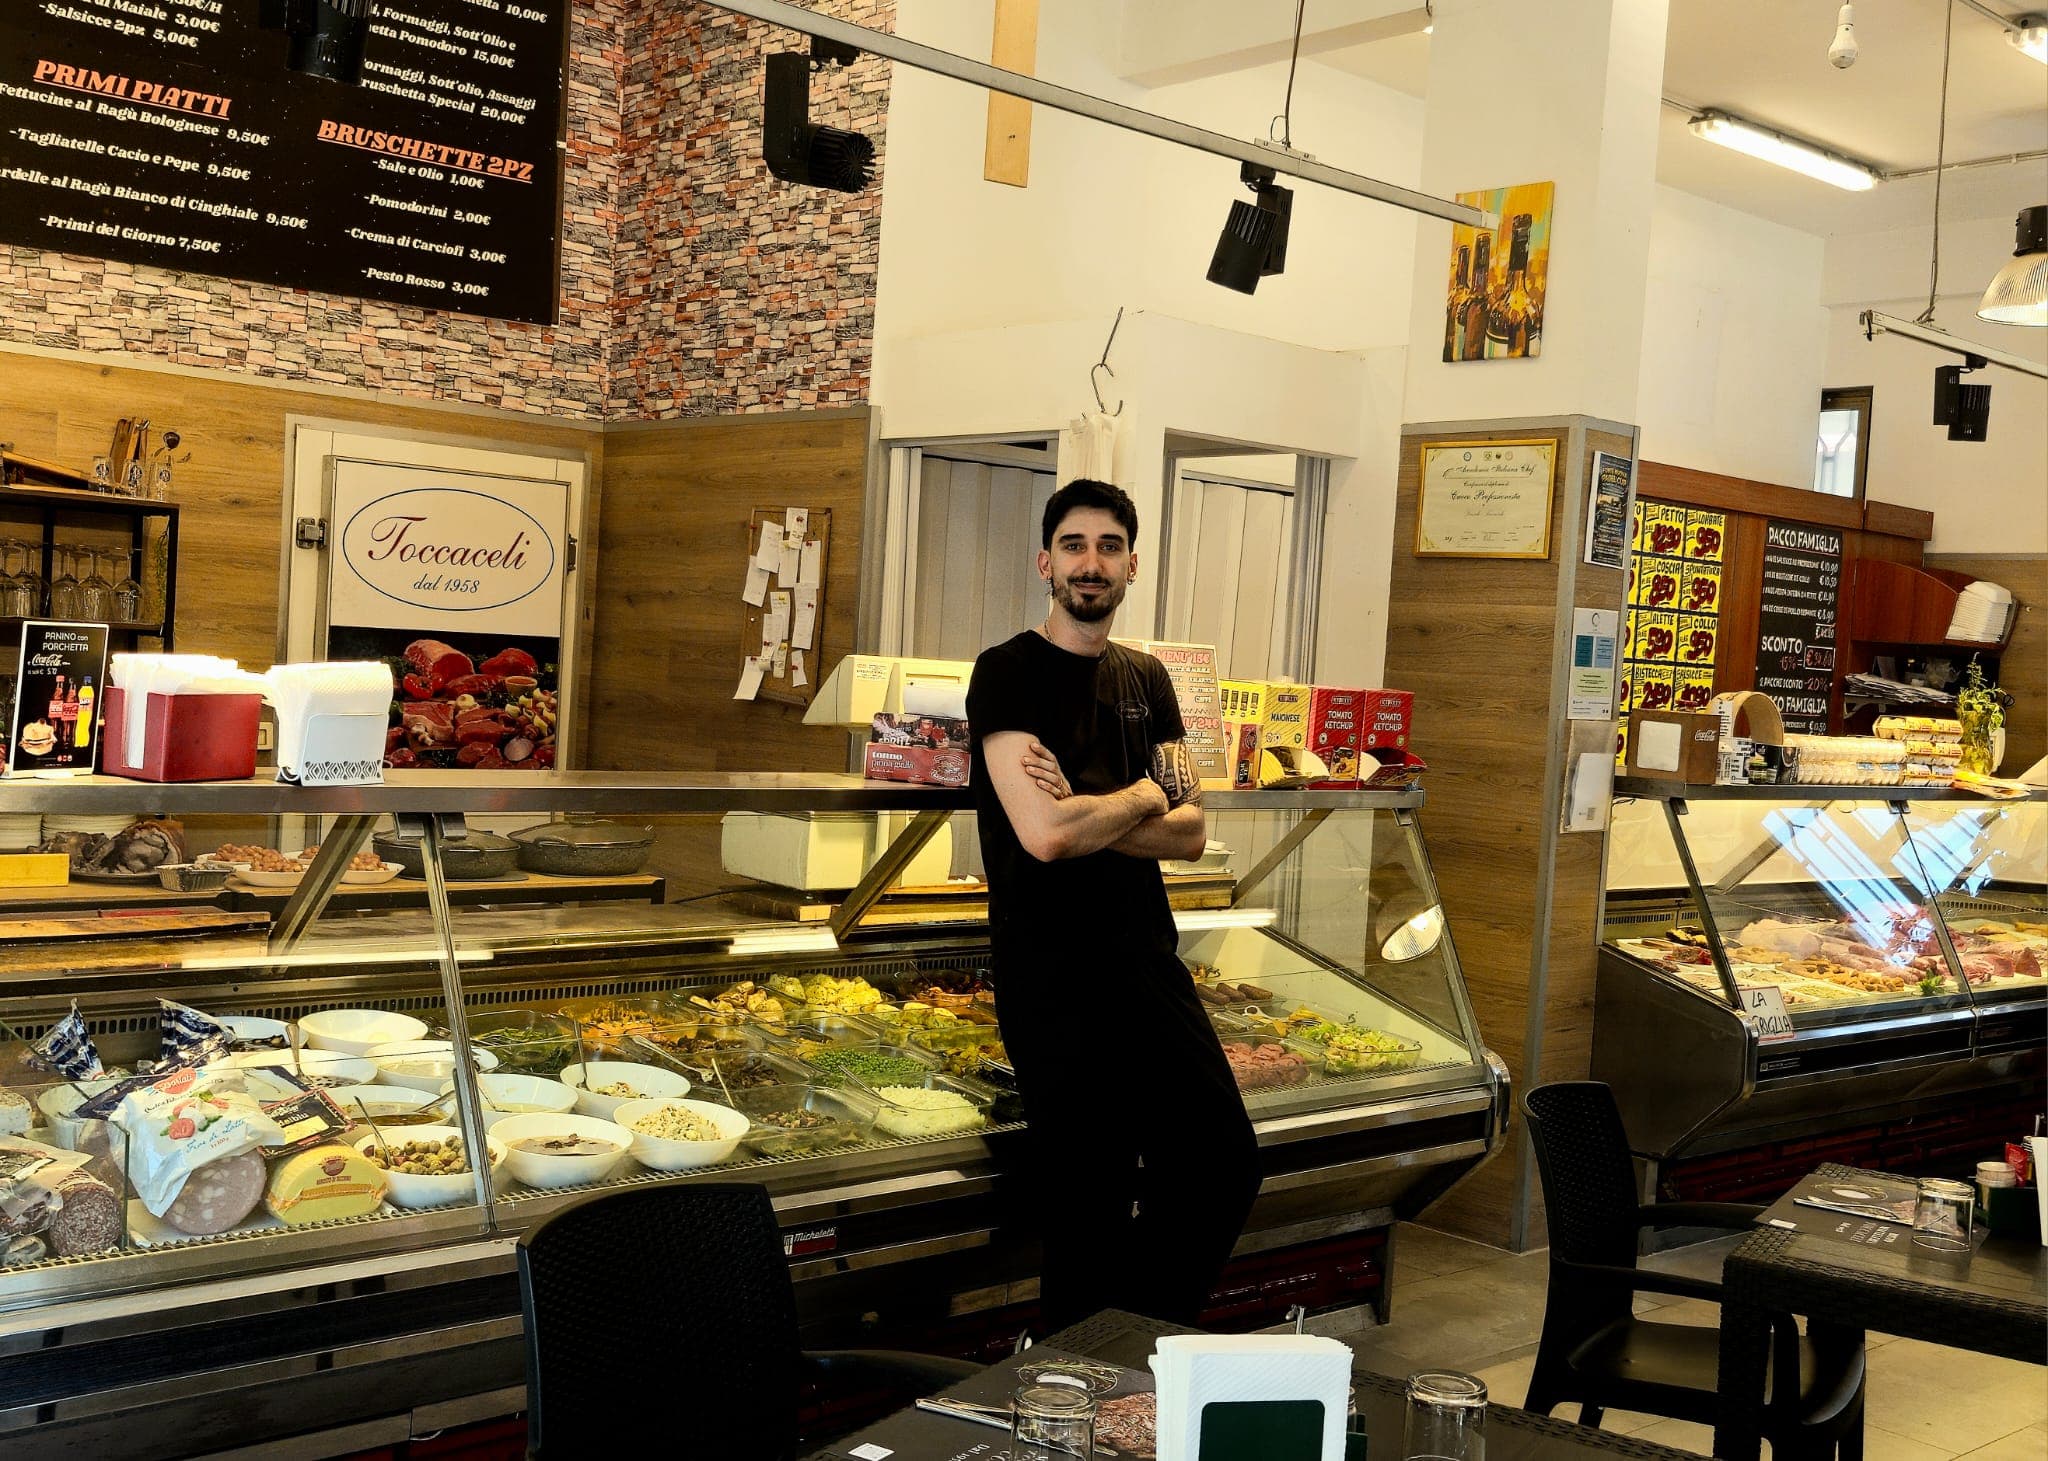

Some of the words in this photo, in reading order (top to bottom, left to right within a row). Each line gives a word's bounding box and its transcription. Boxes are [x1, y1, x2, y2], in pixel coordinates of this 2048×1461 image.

[112, 0, 168, 20] Maiale
[174, 13, 221, 33] 3,00€
[505, 3, 548, 23] 10,00€
[39, 3, 112, 28] -Salsicce
[114, 19, 145, 37] 2pz
[153, 28, 199, 48] 5,00€
[383, 7, 451, 36] Formaggi,
[453, 26, 507, 49] Sott'Olio
[509, 42, 517, 51] e
[399, 30, 467, 56] Pomodoro
[473, 49, 515, 69] 15,00€
[33, 59, 129, 97] PRIMI
[131, 79, 232, 117] PIATTI
[364, 57, 425, 84] ormaggi,
[428, 74, 484, 99] Sott'olio,
[487, 89, 537, 111] Assaggi
[361, 77, 426, 101] ruschetta
[428, 93, 476, 114] Special
[480, 105, 527, 125] 20,00€
[75, 98, 92, 112] al
[96, 102, 138, 122] Ragù
[140, 111, 220, 137] Bolognese
[226, 128, 271, 147] 9,50€
[9, 127, 105, 155] -Tagliatelle
[107, 145, 150, 163] Cacio
[152, 155, 162, 165] e
[163, 155, 200, 173] Pepe
[207, 162, 251, 181] 9,50€
[317, 119, 485, 171] BRUSCHETTE
[487, 156, 535, 181] 2PZ
[408, 167, 416, 175] e
[418, 167, 444, 181] Olio
[450, 173, 484, 189] 1,00€
[51, 175, 68, 189] al
[69, 176, 111, 197] Ragù
[113, 185, 168, 205] Bianco
[170, 195, 186, 209] di
[188, 198, 259, 222] Cinghiale
[265, 212, 309, 230] 9,50€
[364, 194, 448, 218] -Pomodorini
[453, 210, 491, 227] 2,00€
[40, 215, 94, 234] -Primi
[96, 222, 119, 237] del
[121, 227, 176, 247] Giorno
[178, 236, 222, 253] 7,50€
[345, 227, 395, 246] -Crema
[397, 235, 411, 247] di
[412, 237, 464, 257] Carciofi
[469, 248, 506, 264] 3,00€
[361, 267, 404, 284] -Pesto
[406, 274, 446, 290] Rosso
[452, 281, 490, 297] 3,00€
[1661, 508, 1684, 523] PETTO
[368, 516, 530, 570] Toccaceli
[1769, 527, 1796, 547] PACCO
[1798, 531, 1840, 553] FAMIGLIA
[1656, 561, 1680, 575] COSCIA
[413, 573, 439, 592] dal
[444, 578, 480, 594] 1958
[1652, 613, 1674, 626] ALETTE
[1694, 618, 1716, 630] COLLO
[45, 631, 77, 641] PANINO
[1761, 636, 1803, 654] SCONTO
[42, 642, 89, 652] PORCHETTA
[1328, 711, 1353, 719] TOMATO
[1786, 696, 1827, 714] FAMIGLIA
[1271, 713, 1301, 723] MAIONESE
[1325, 721, 1354, 730] KETCHUP
[1373, 723, 1402, 732] KETCHUP
[1376, 713, 1402, 721] TOMATO
[872, 751, 903, 760] tonno
[1752, 990, 1768, 1009] LA
[794, 1226, 837, 1243] Micheletti
